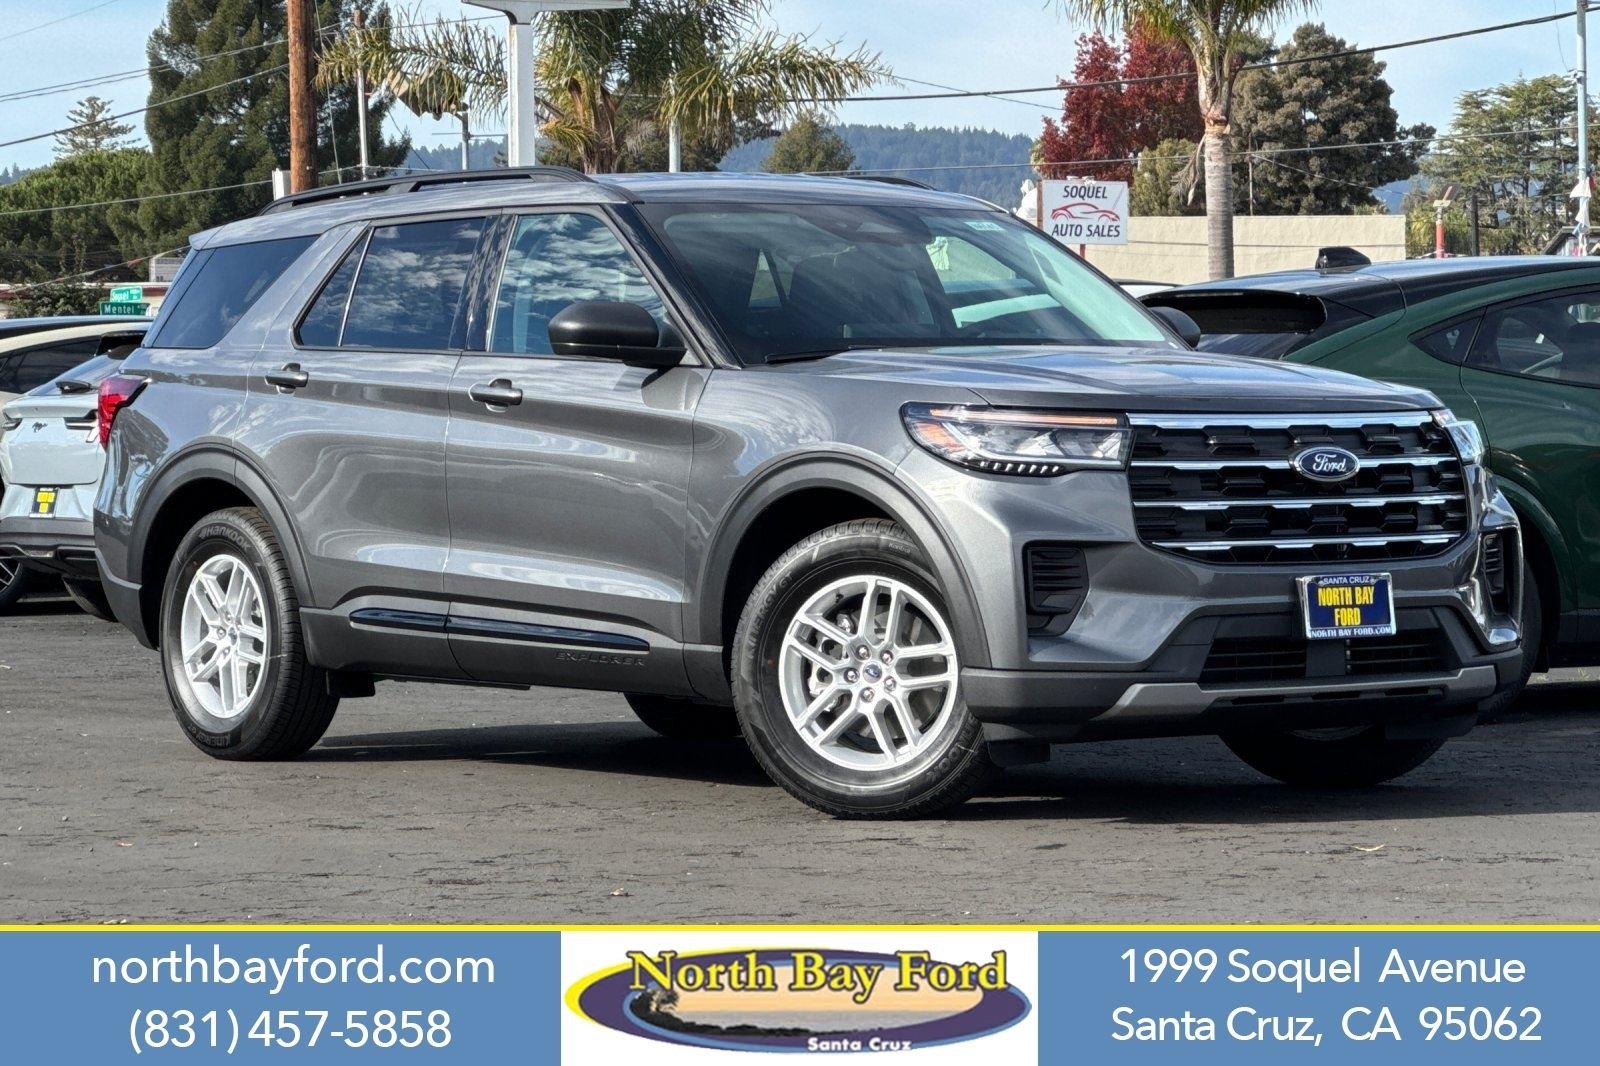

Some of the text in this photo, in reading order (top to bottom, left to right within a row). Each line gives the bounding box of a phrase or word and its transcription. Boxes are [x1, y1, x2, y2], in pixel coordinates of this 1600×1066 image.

[1063, 185, 1108, 200] SOQUEL
[1051, 224, 1120, 237] AUTO SALES
[1312, 453, 1346, 472] Ford
[1323, 576, 1370, 585] SANTA CRUZ
[1317, 586, 1375, 606] NORTH BAY
[1334, 607, 1361, 627] FORD
[1311, 629, 1337, 639] NORTH
[1338, 629, 1352, 637] BAY
